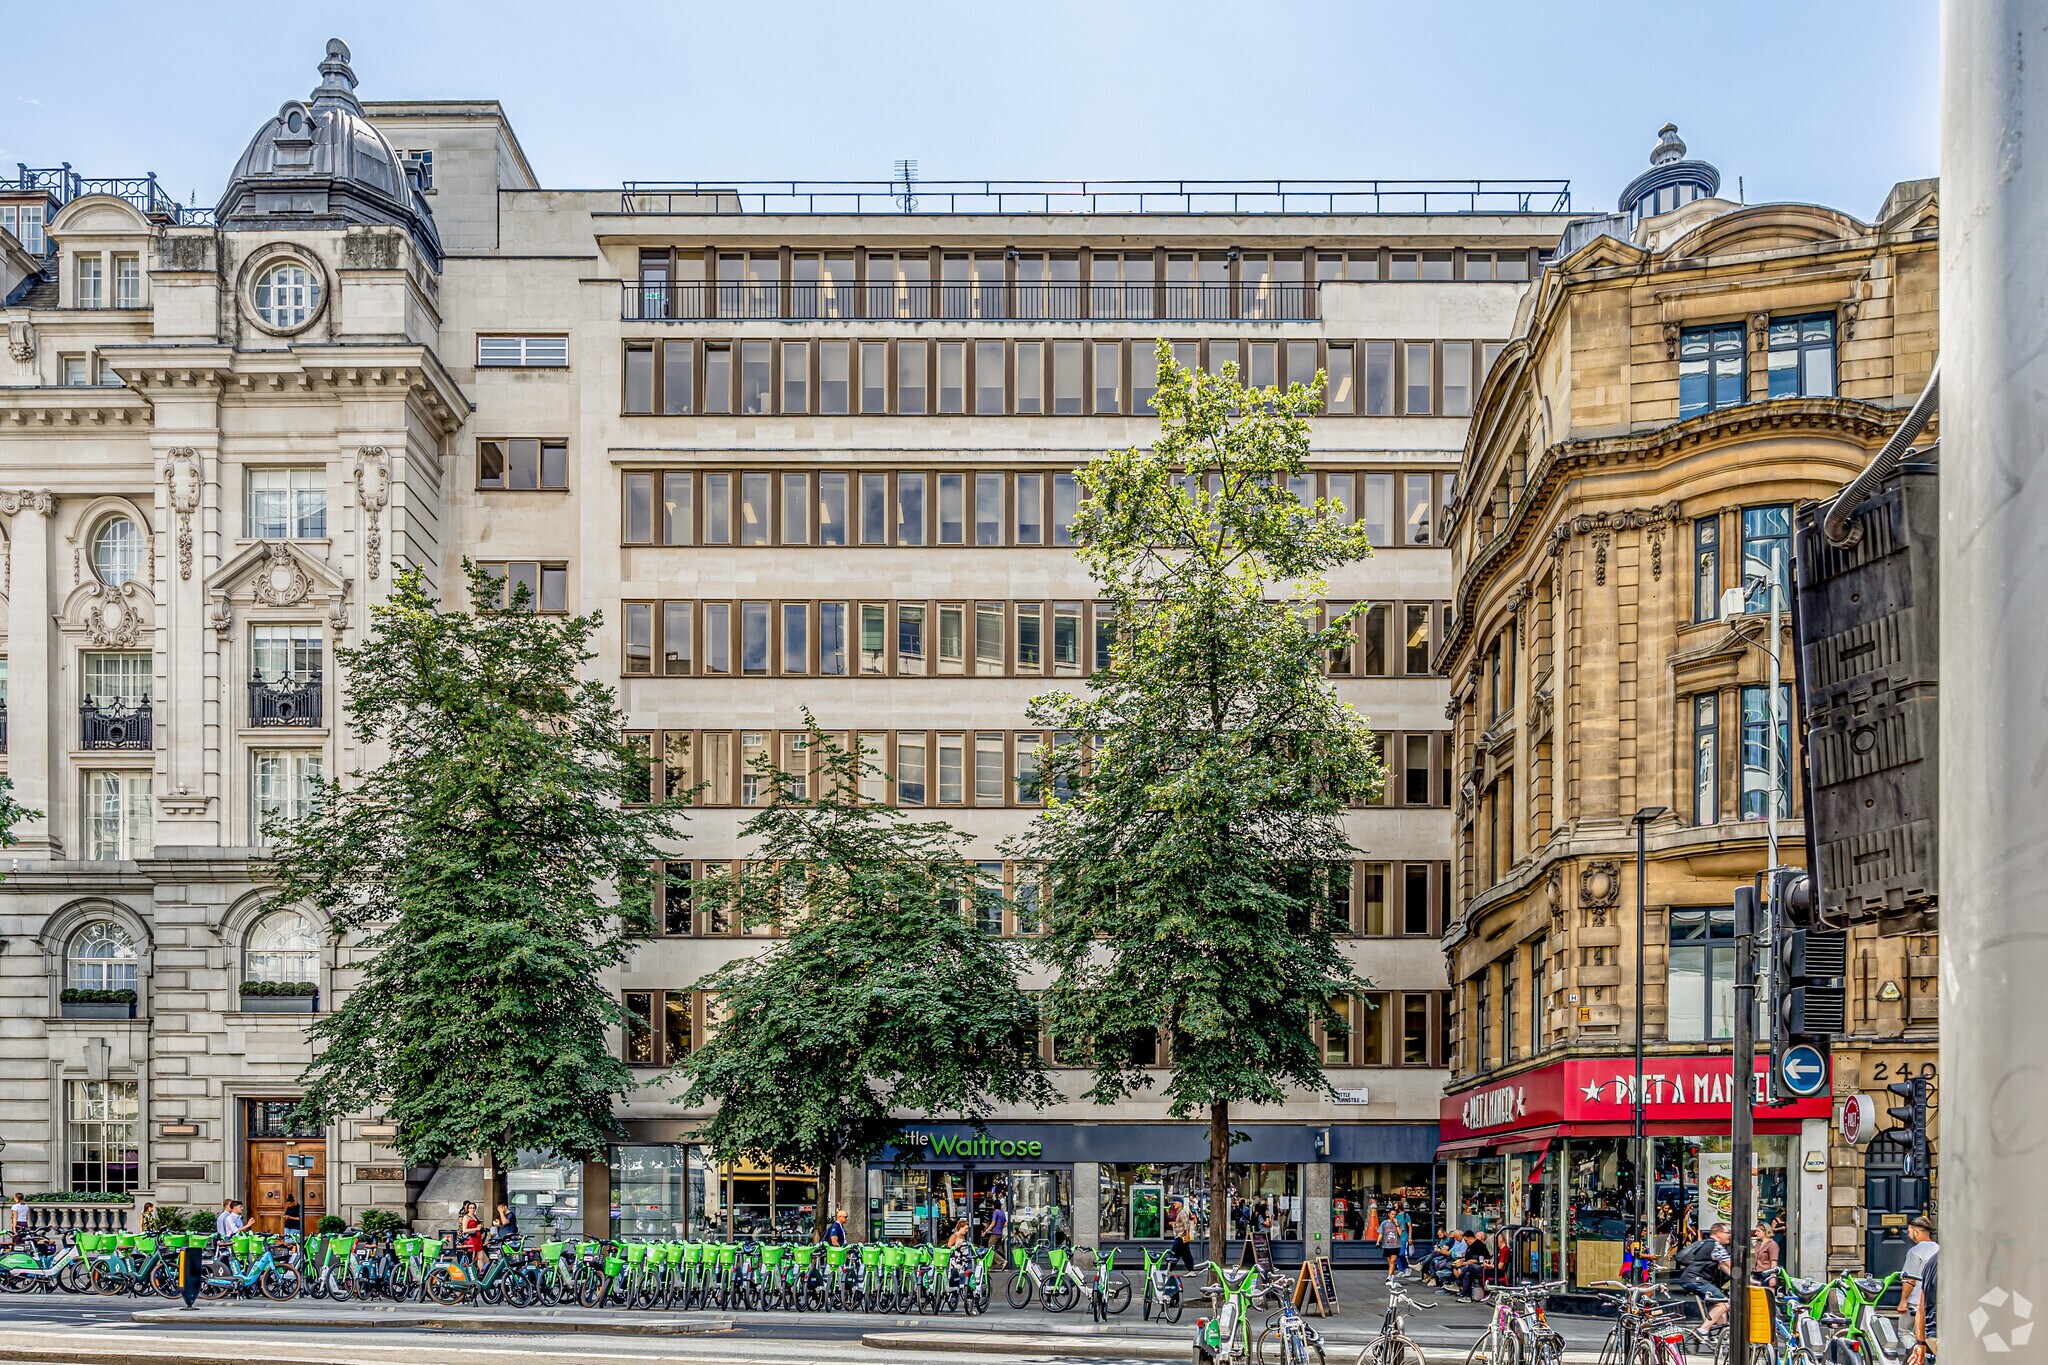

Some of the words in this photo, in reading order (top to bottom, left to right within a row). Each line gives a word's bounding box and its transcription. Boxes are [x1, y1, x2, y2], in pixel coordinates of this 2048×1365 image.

[1580, 1009, 1590, 1020] H
[1873, 1061, 1937, 1081] 240
[1671, 1073, 1686, 1104] A
[1469, 1093, 1485, 1130] PRET
[1483, 1092, 1489, 1127] A
[929, 1132, 1043, 1156] Waitrose
